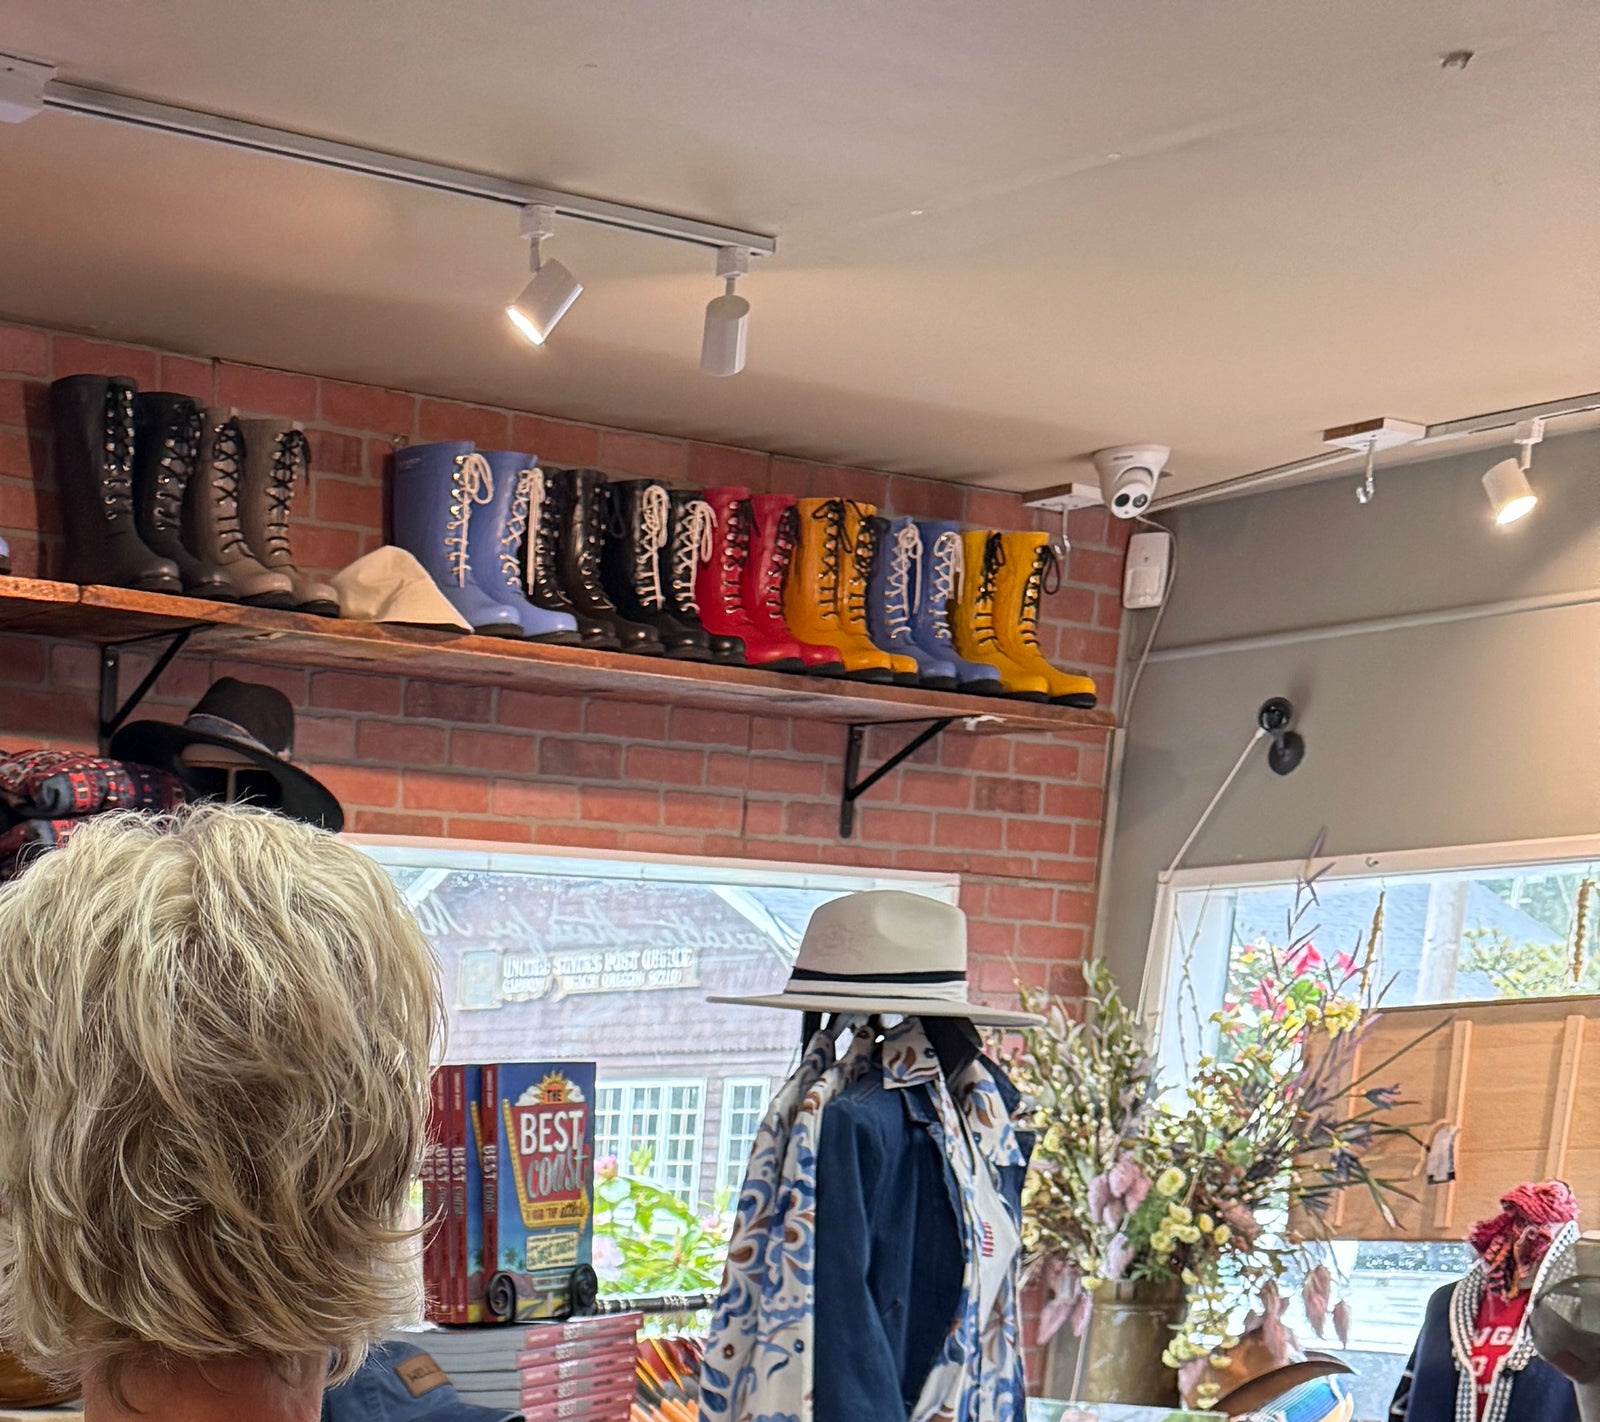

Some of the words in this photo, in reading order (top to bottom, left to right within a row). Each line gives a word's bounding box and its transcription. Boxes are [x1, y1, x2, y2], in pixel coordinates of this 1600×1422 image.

[519, 1109, 585, 1156] BEST
[452, 1147, 466, 1183] BEST
[483, 1144, 497, 1180] BEST
[527, 1136, 590, 1199] coast
